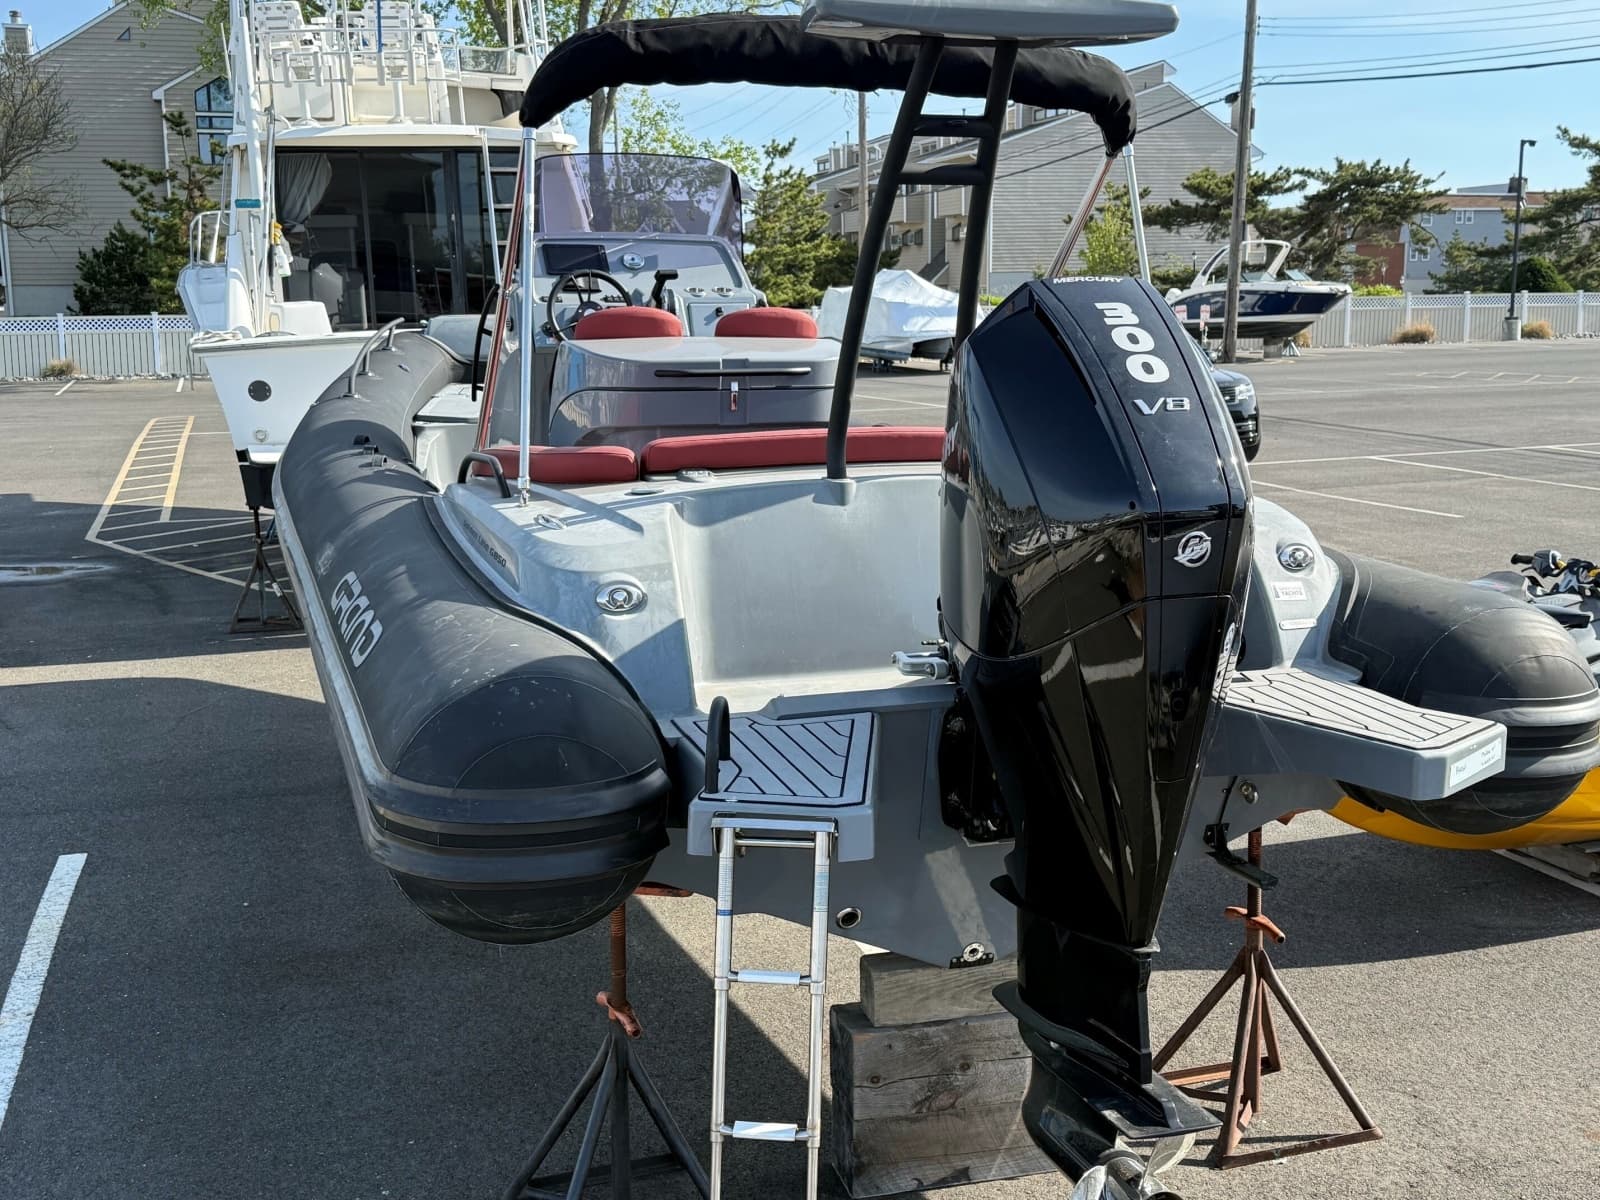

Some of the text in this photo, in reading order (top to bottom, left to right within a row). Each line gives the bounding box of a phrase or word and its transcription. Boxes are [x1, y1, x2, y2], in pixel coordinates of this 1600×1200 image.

[1053, 276, 1123, 284] MERCURY
[1094, 302, 1170, 383] 300
[1133, 397, 1190, 415] V8
[331, 570, 383, 668] GRAND
